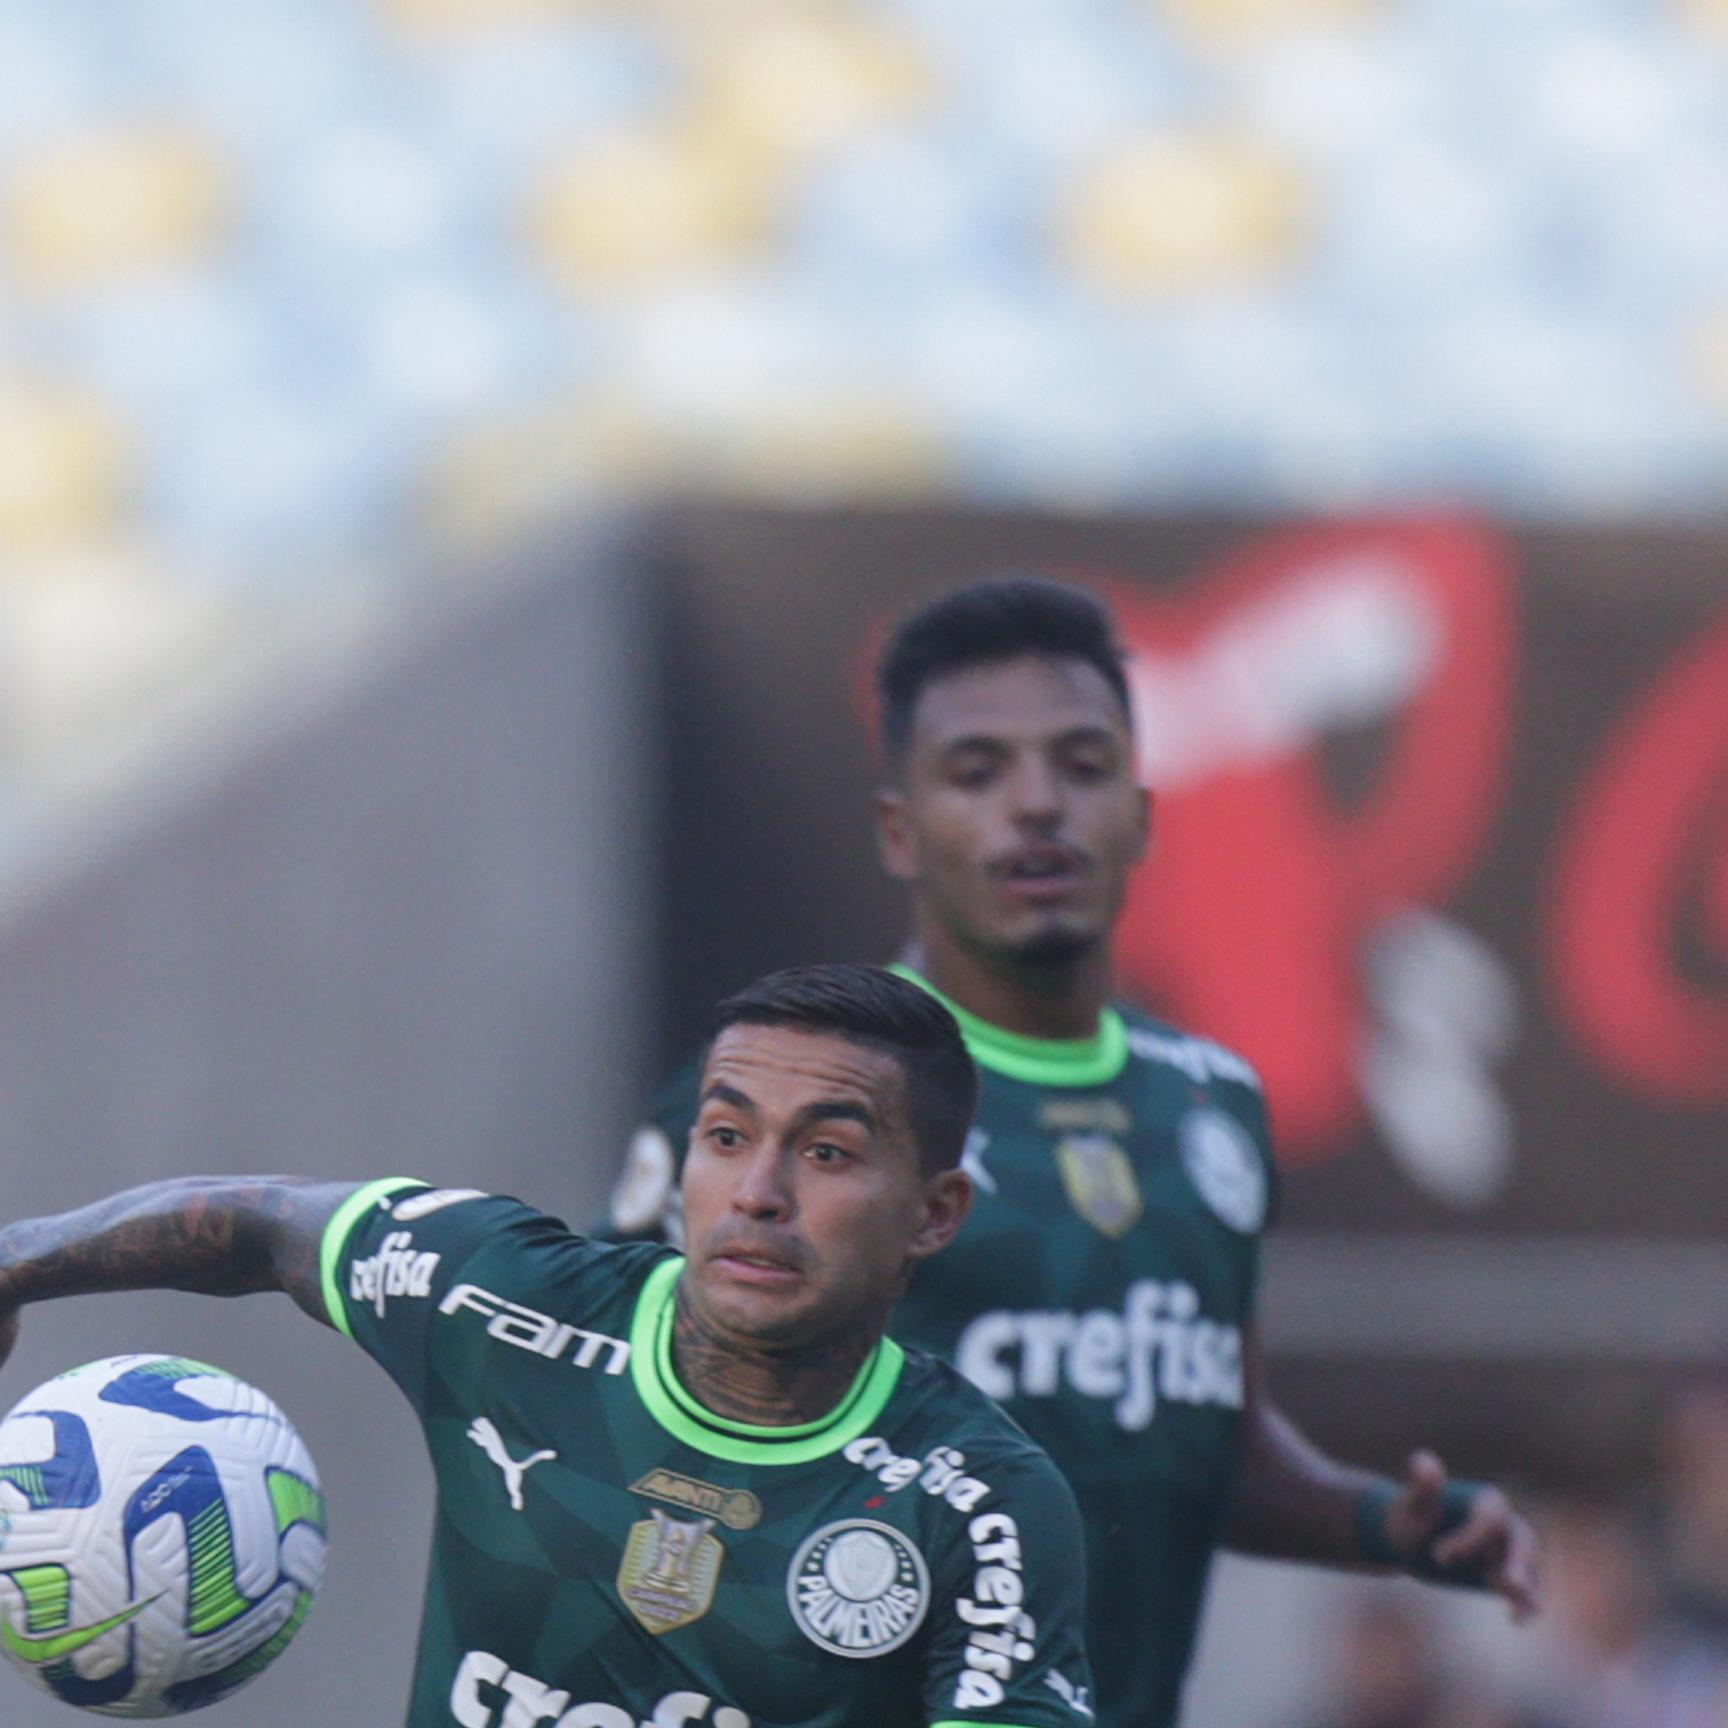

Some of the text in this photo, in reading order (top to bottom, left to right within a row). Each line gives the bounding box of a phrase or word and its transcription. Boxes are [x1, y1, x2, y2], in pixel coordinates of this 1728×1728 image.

[438, 1284, 632, 1376] Fam
[798, 1575, 920, 1648] PALMEIRAS
[954, 1513, 1036, 1710] crefisa
